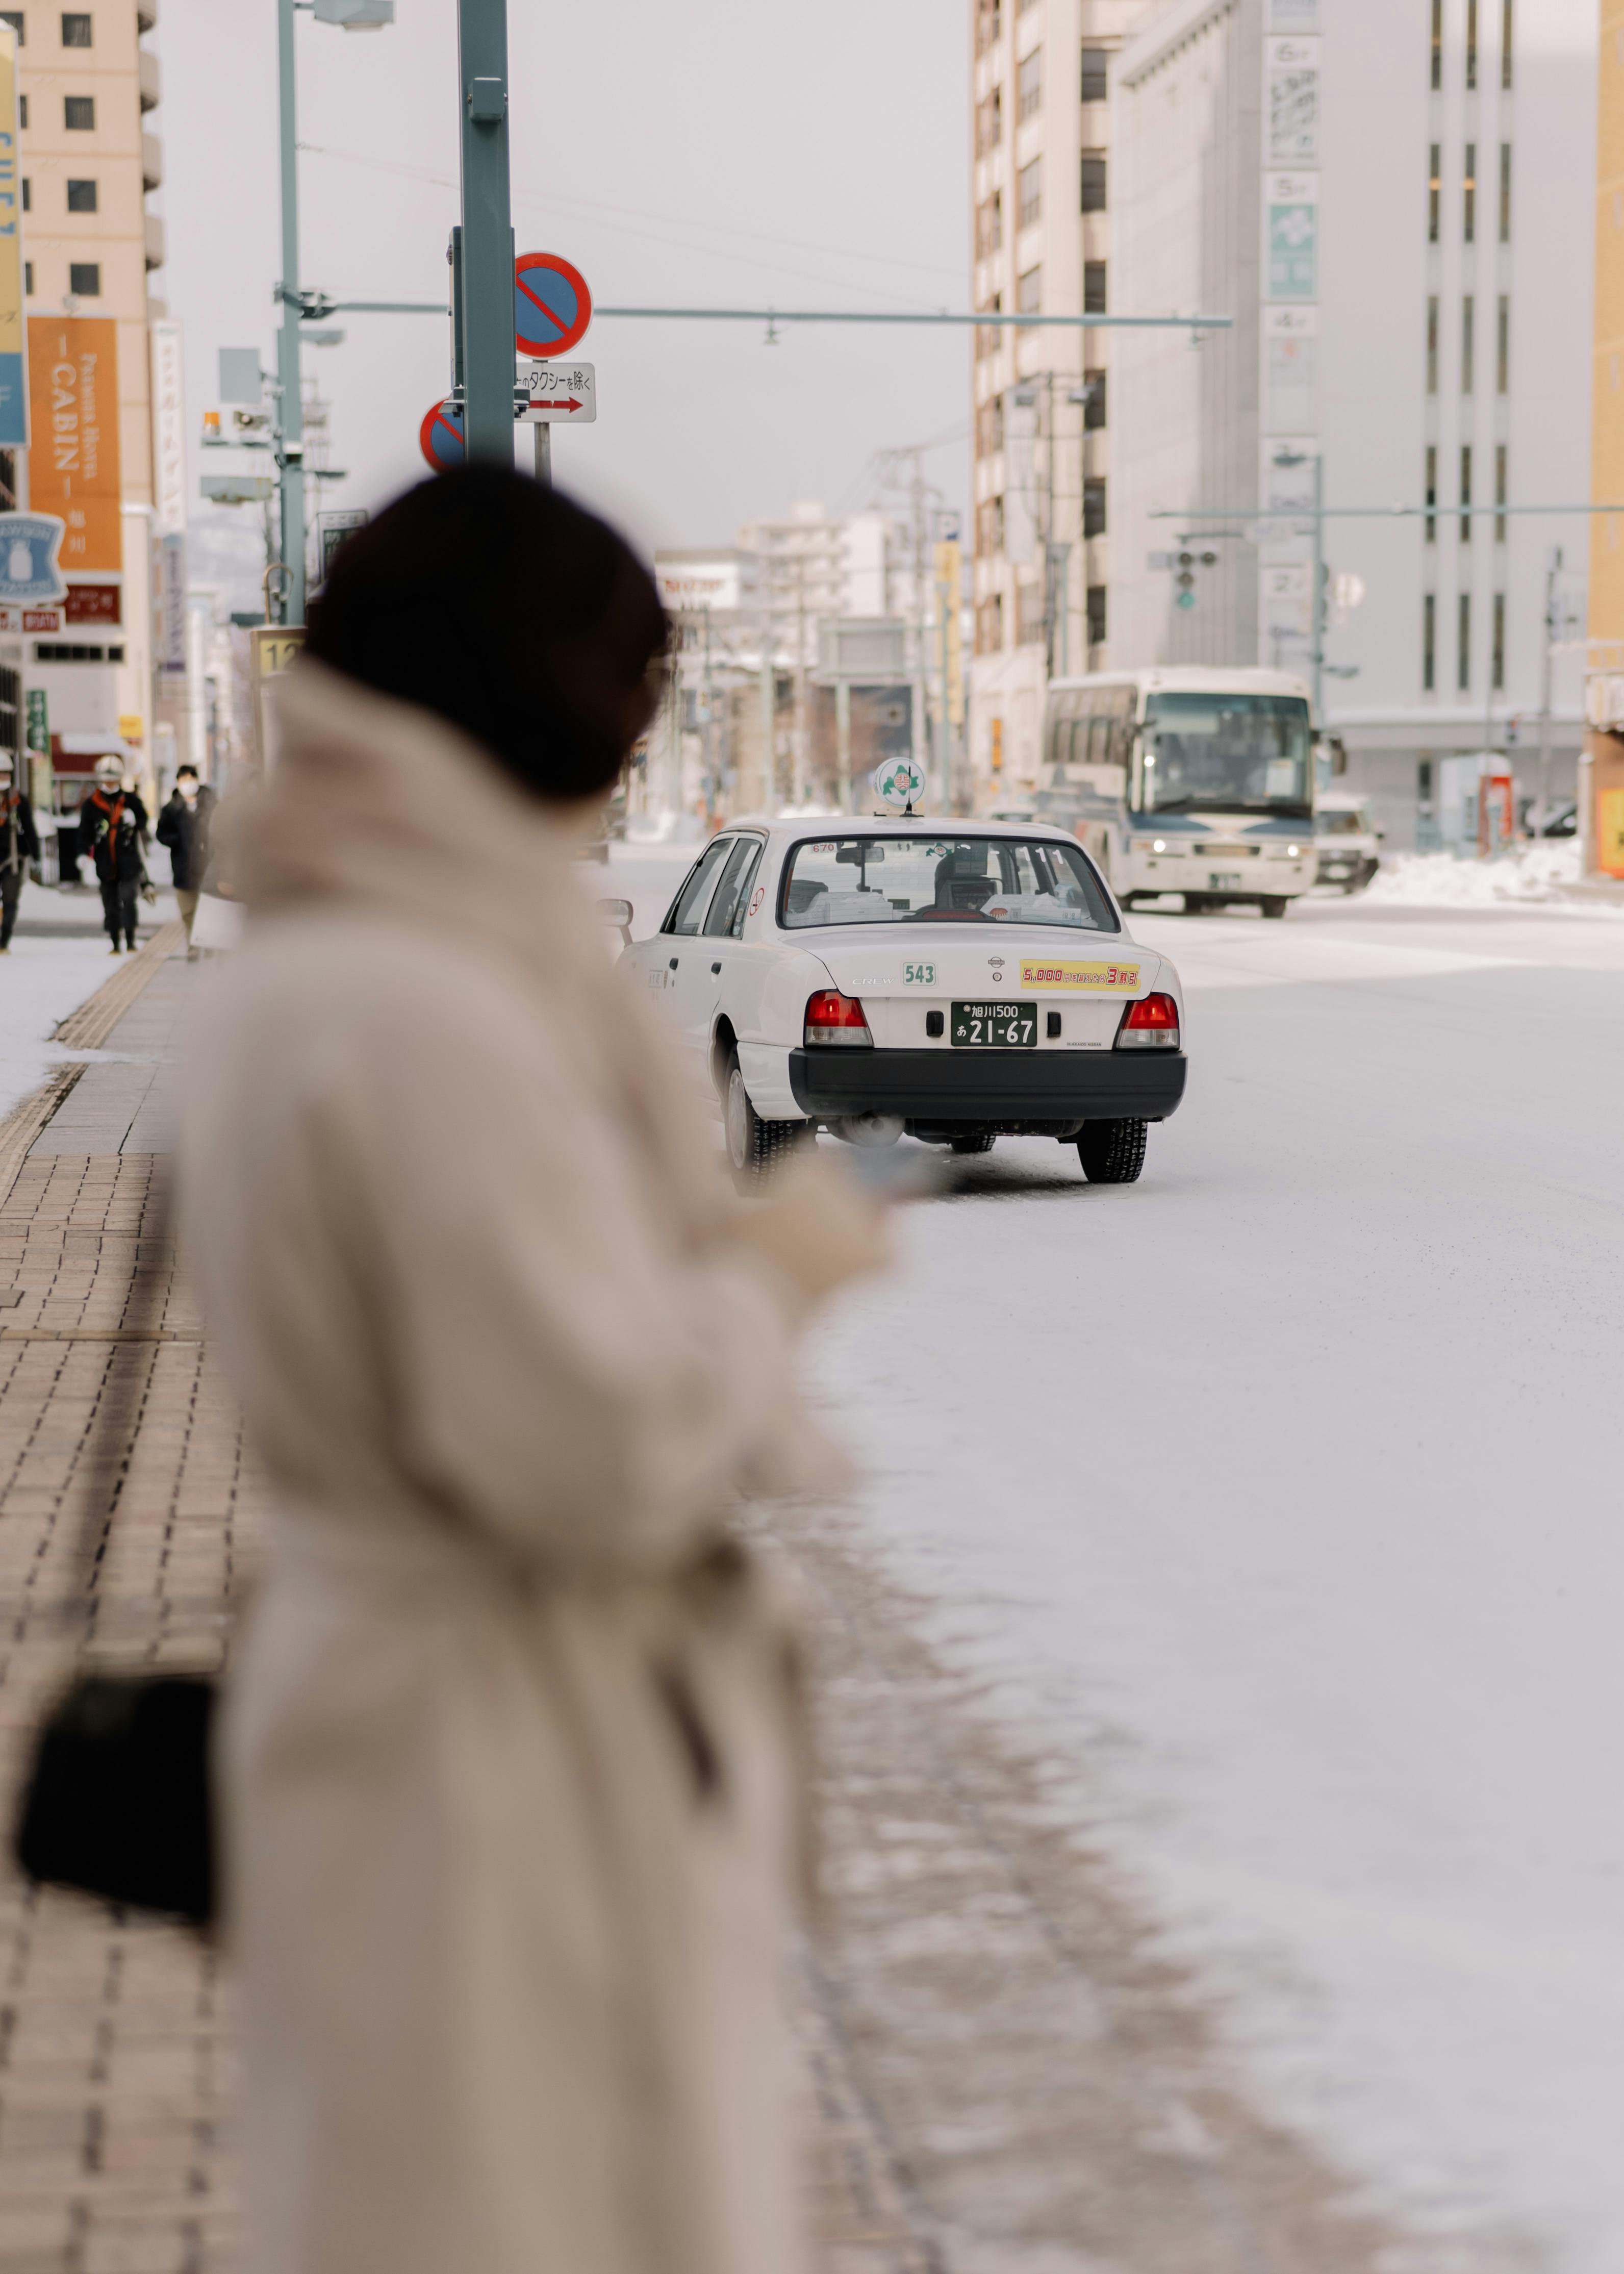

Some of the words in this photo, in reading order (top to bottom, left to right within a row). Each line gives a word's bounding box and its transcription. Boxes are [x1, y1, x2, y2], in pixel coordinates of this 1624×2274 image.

[53, 363, 79, 470] CABIN
[813, 844, 834, 852] 670
[906, 965, 934, 983] 543
[1023, 967, 1137, 986] 5,000円を超えた分3割引
[972, 1005, 1018, 1018] 旭川500
[957, 1025, 967, 1037] あ
[970, 1020, 1033, 1043] 21-67
